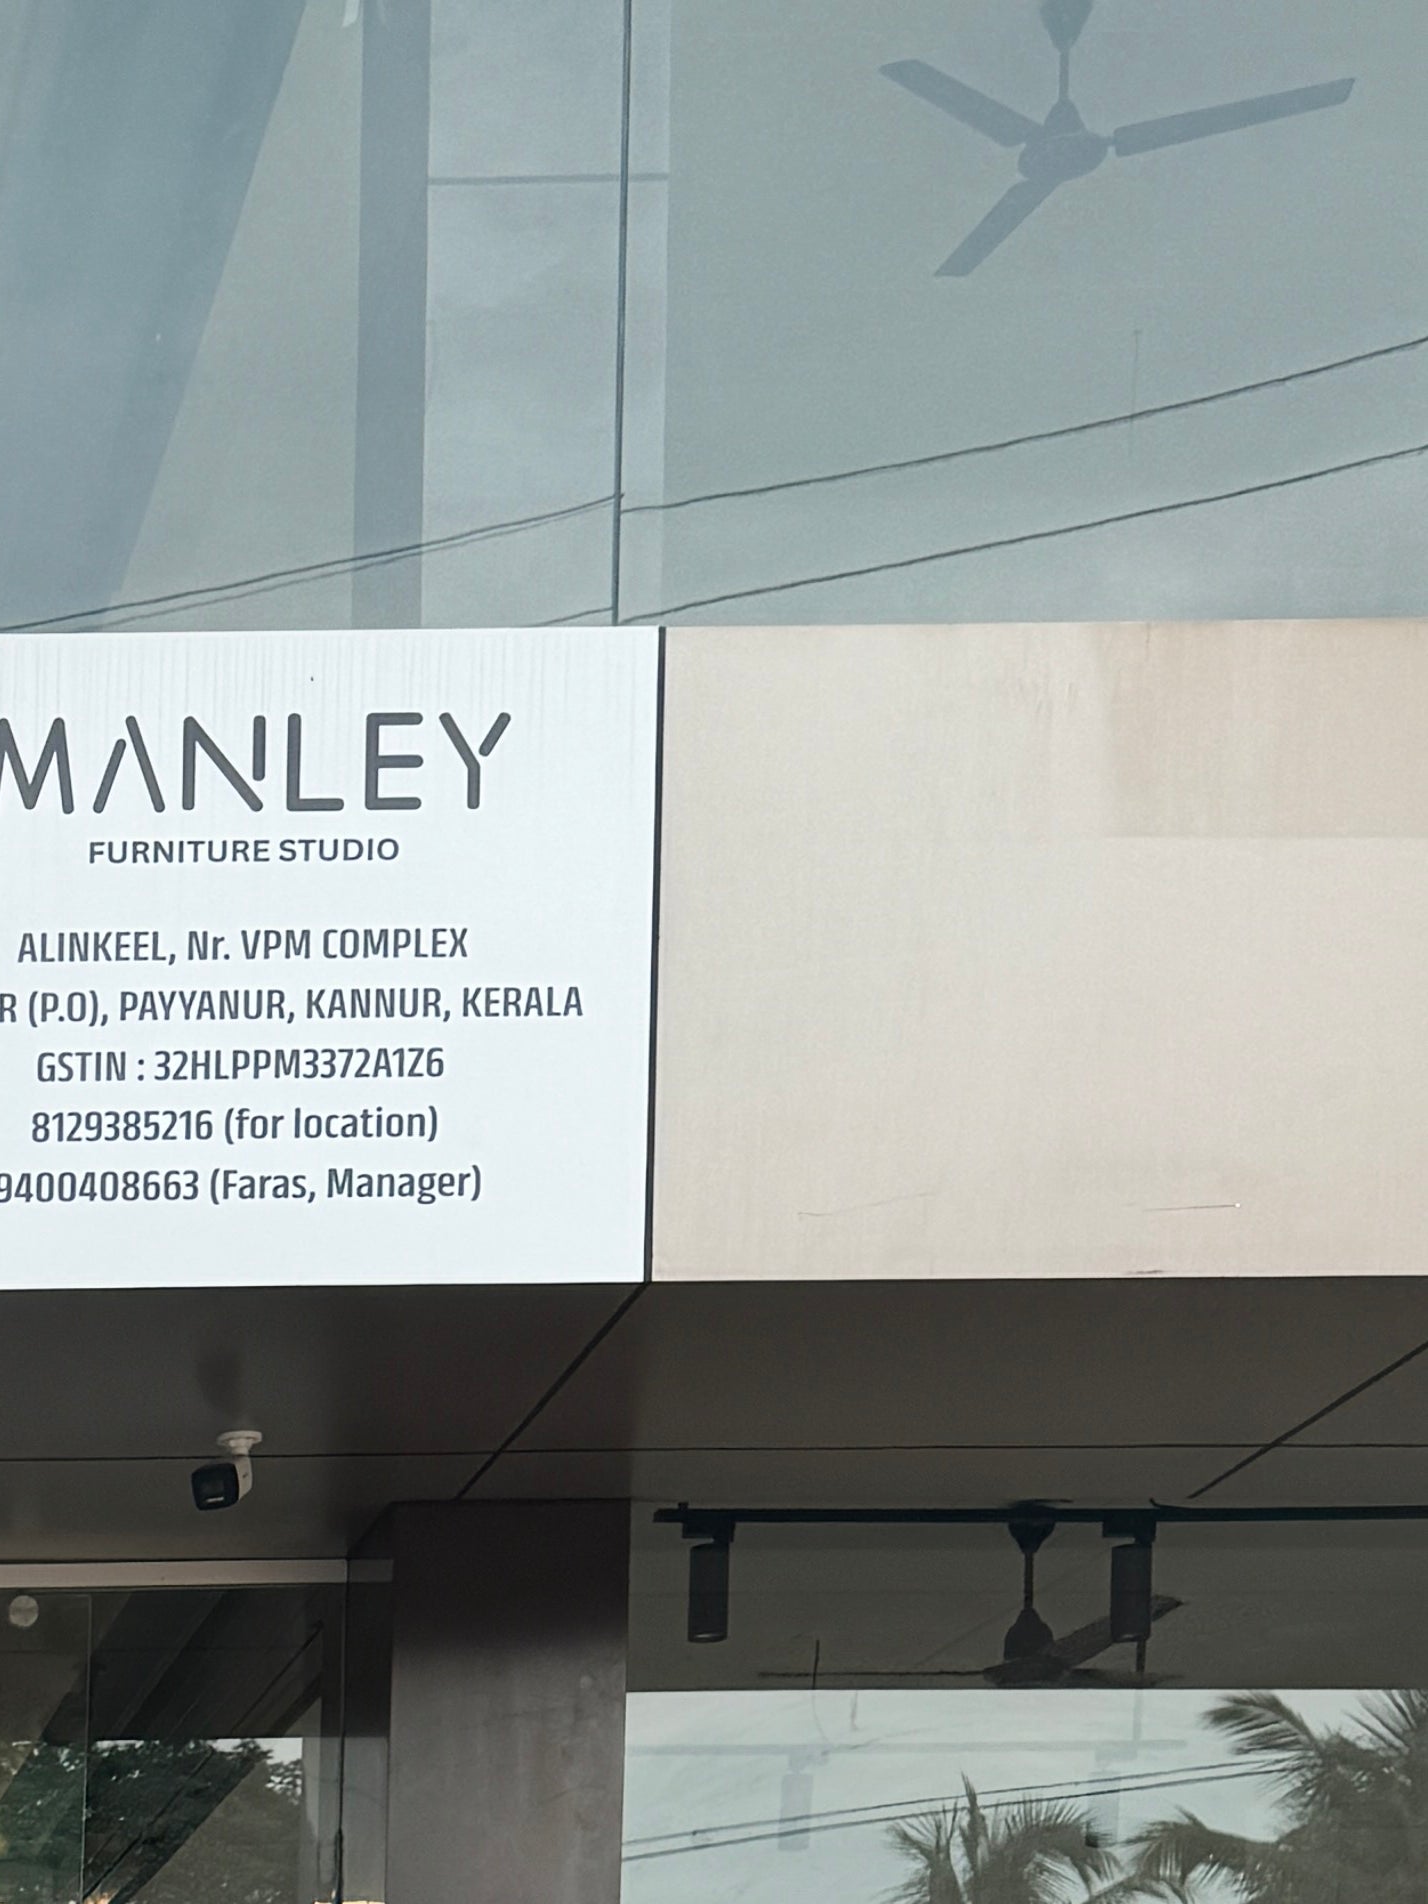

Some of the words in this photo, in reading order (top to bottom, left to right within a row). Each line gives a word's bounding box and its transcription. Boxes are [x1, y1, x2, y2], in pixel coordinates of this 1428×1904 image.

[90, 840, 269, 863] FURNITURE
[280, 839, 398, 861] STUDIO
[18, 932, 175, 965] ALINKEEL,
[188, 931, 229, 960] Nr.
[241, 930, 310, 959] VPM
[324, 928, 467, 958] COMPLEX
[29, 990, 108, 1027] (P.O),
[120, 990, 294, 1023] PAYYANUR,
[307, 988, 450, 1022] KANNUR,
[463, 987, 582, 1017] KERALA
[38, 1052, 125, 1082] GSTIN
[155, 1048, 443, 1080] 32HLPPM3372A1Z6
[33, 1110, 212, 1142] 8129385216
[225, 1108, 284, 1144] (for
[295, 1106, 437, 1142] location)
[211, 1168, 315, 1205] (Faras,
[328, 1165, 480, 1204] Manager)
